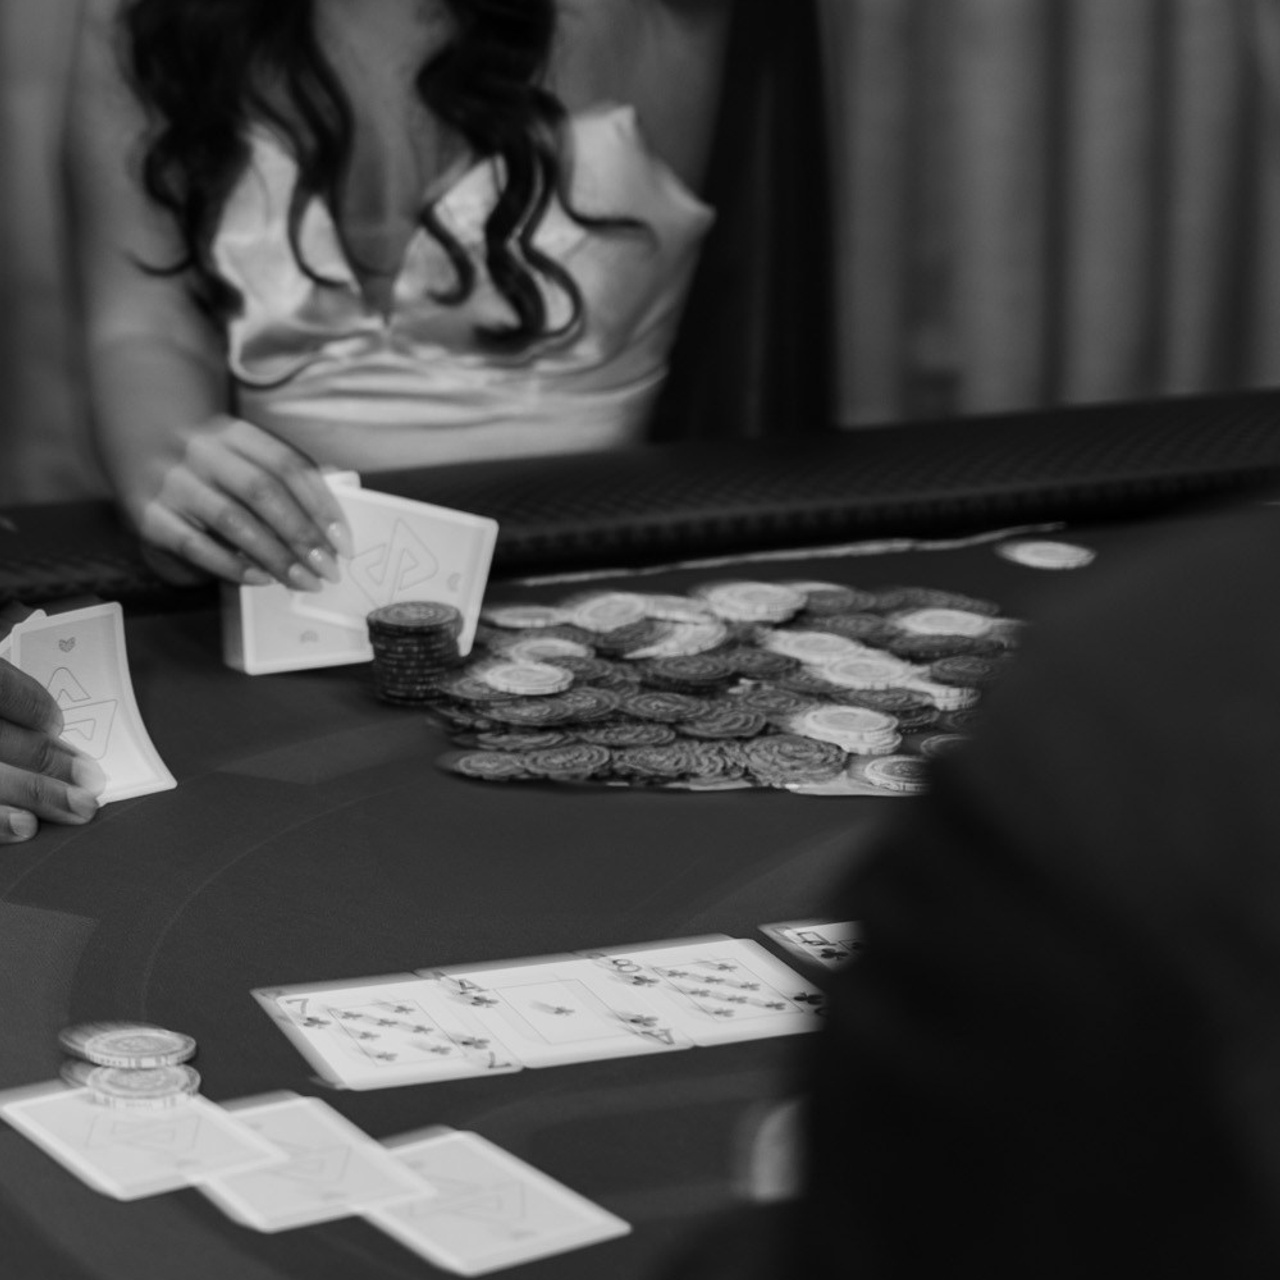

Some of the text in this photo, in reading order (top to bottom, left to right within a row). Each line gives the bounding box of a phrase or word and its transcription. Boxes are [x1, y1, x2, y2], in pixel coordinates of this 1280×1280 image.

[797, 931, 837, 946] Q
[612, 958, 641, 972] 8
[459, 979, 488, 995] A
[286, 998, 310, 1017] 7
[488, 1051, 512, 1069] 7
